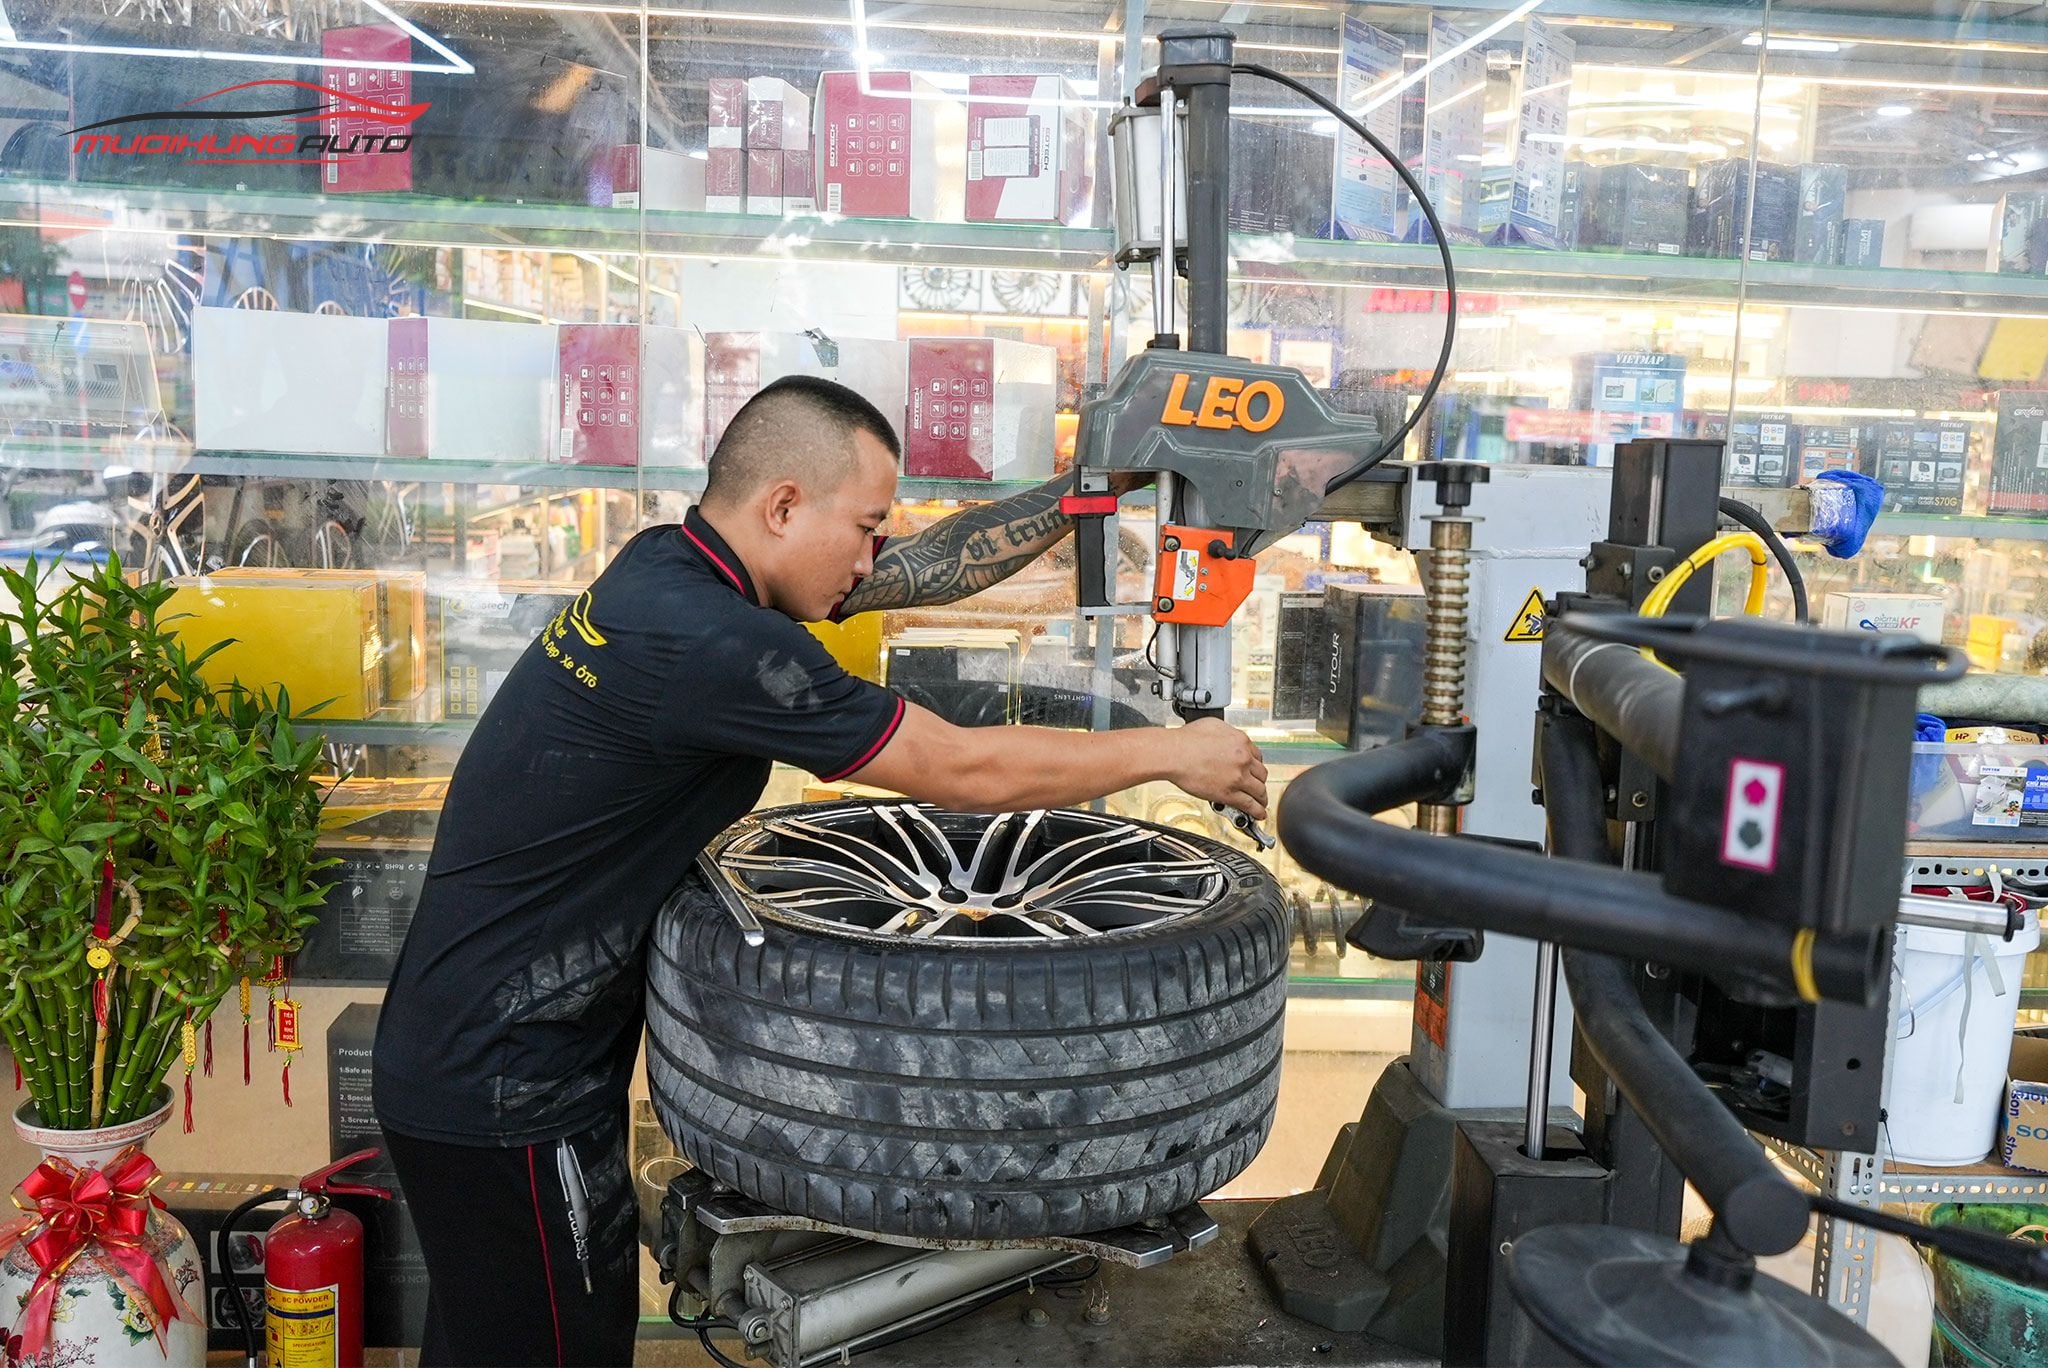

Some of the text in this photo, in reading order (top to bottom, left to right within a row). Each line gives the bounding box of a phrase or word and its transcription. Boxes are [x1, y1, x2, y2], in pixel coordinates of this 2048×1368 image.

[1615, 354, 1665, 365] VIETMAP
[1160, 373, 1285, 433] LEO
[1934, 496, 1958, 507] S70G
[1899, 617, 1920, 629] KF
[560, 653, 574, 670] Xe
[1329, 632, 1340, 694] UTOUR
[338, 1048, 372, 1056] Product
[293, 1294, 329, 1304] POWDER
